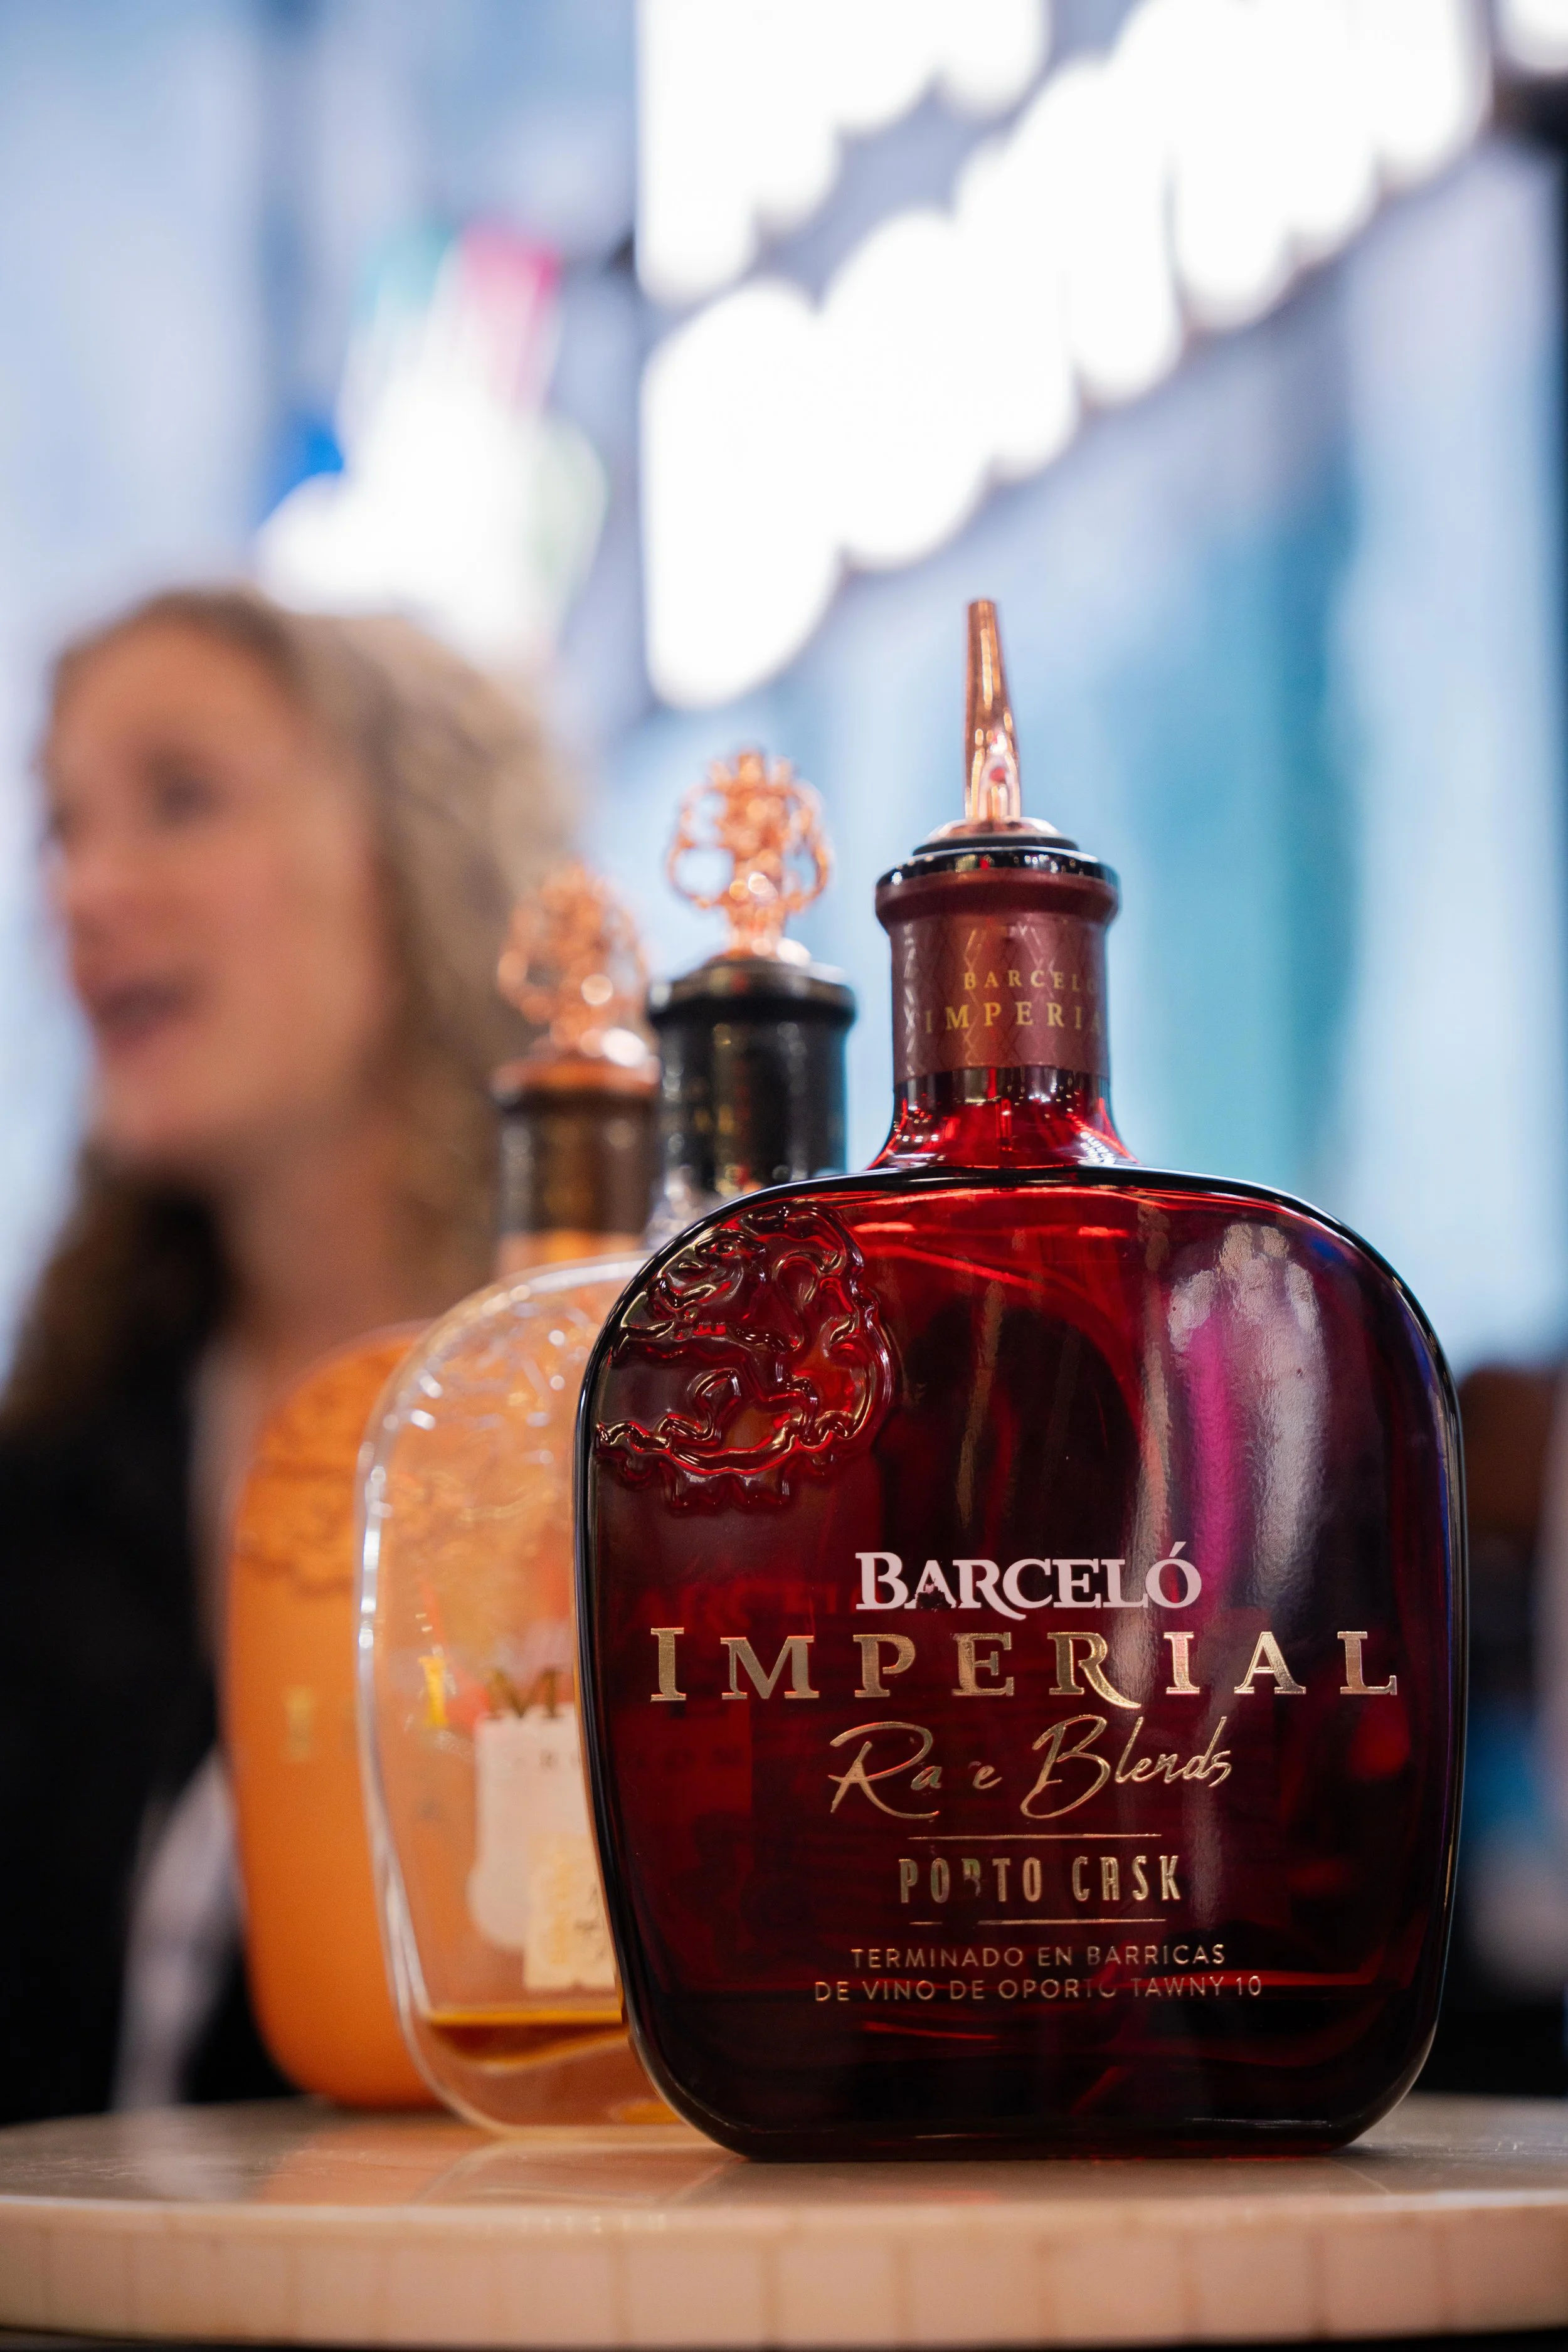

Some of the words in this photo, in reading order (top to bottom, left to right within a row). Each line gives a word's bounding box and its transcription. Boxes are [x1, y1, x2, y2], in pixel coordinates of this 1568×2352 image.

[855, 1541, 1202, 1621] BARCELÓ
[650, 1626, 1398, 1710] IMPERIAL
[827, 1721, 1003, 1820] Rae
[1019, 1714, 1232, 1820] Blends
[1071, 1855, 1182, 1902] CASK
[850, 1947, 1024, 1968] TERMINADO
[1037, 1946, 1073, 1967] EN
[1086, 1944, 1225, 1965] BARRICAS
[815, 1981, 850, 2002] DE
[861, 1979, 936, 2001] VINO
[949, 1979, 985, 2000] DE
[1130, 1976, 1224, 1998] TAWNY
[1235, 1974, 1263, 1996] 10
